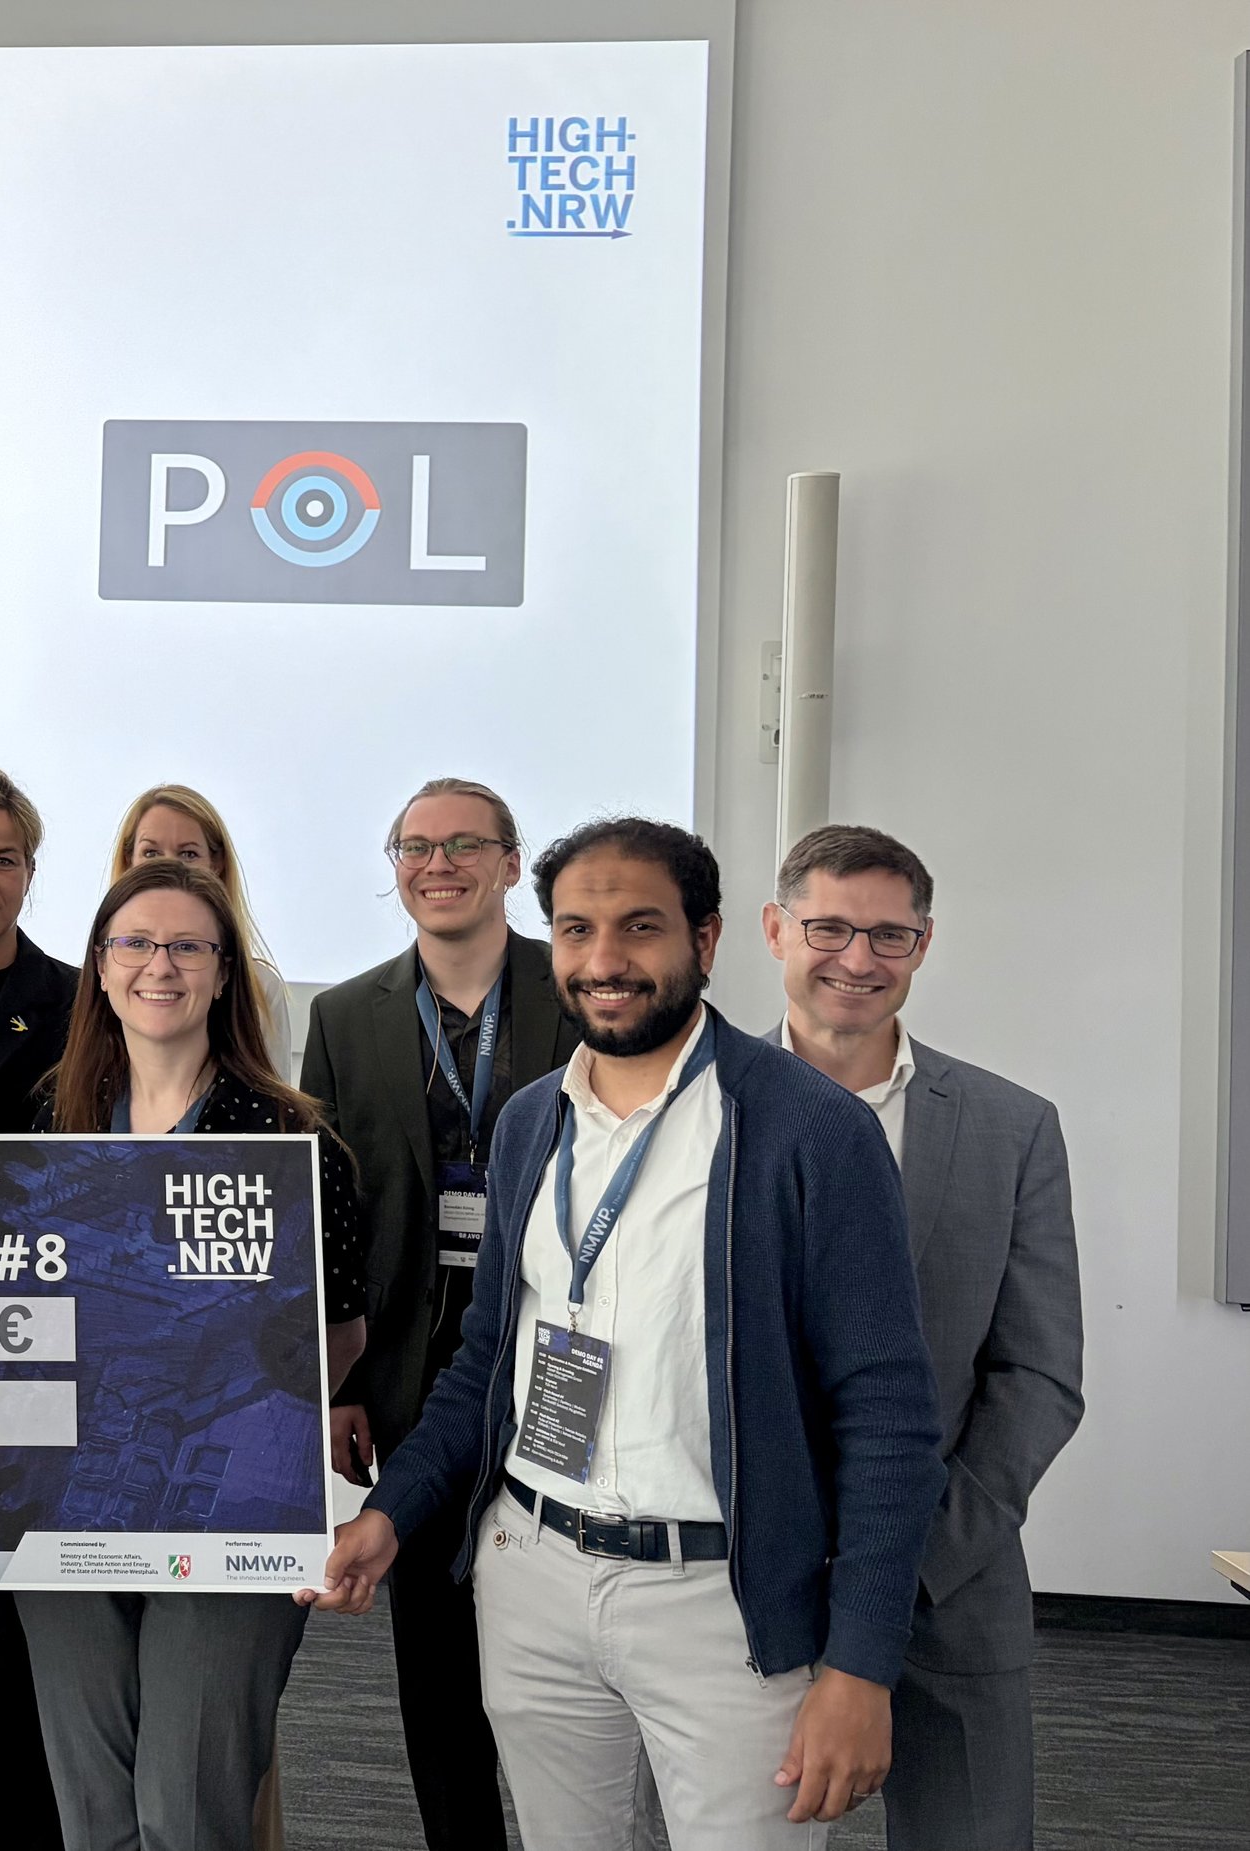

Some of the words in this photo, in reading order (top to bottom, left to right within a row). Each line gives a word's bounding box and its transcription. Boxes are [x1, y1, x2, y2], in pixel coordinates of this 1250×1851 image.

[508, 117, 636, 153] HIGH-
[508, 155, 636, 192] TECH
[506, 193, 634, 229] .NRW
[480, 1012, 496, 1056] NMWP.
[165, 1173, 273, 1206] HIGH-
[166, 1207, 275, 1240] TECH
[579, 1206, 615, 1264] NMWP.
[167, 1241, 274, 1273] .NRW
[225, 1555, 304, 1572] NMWP.
